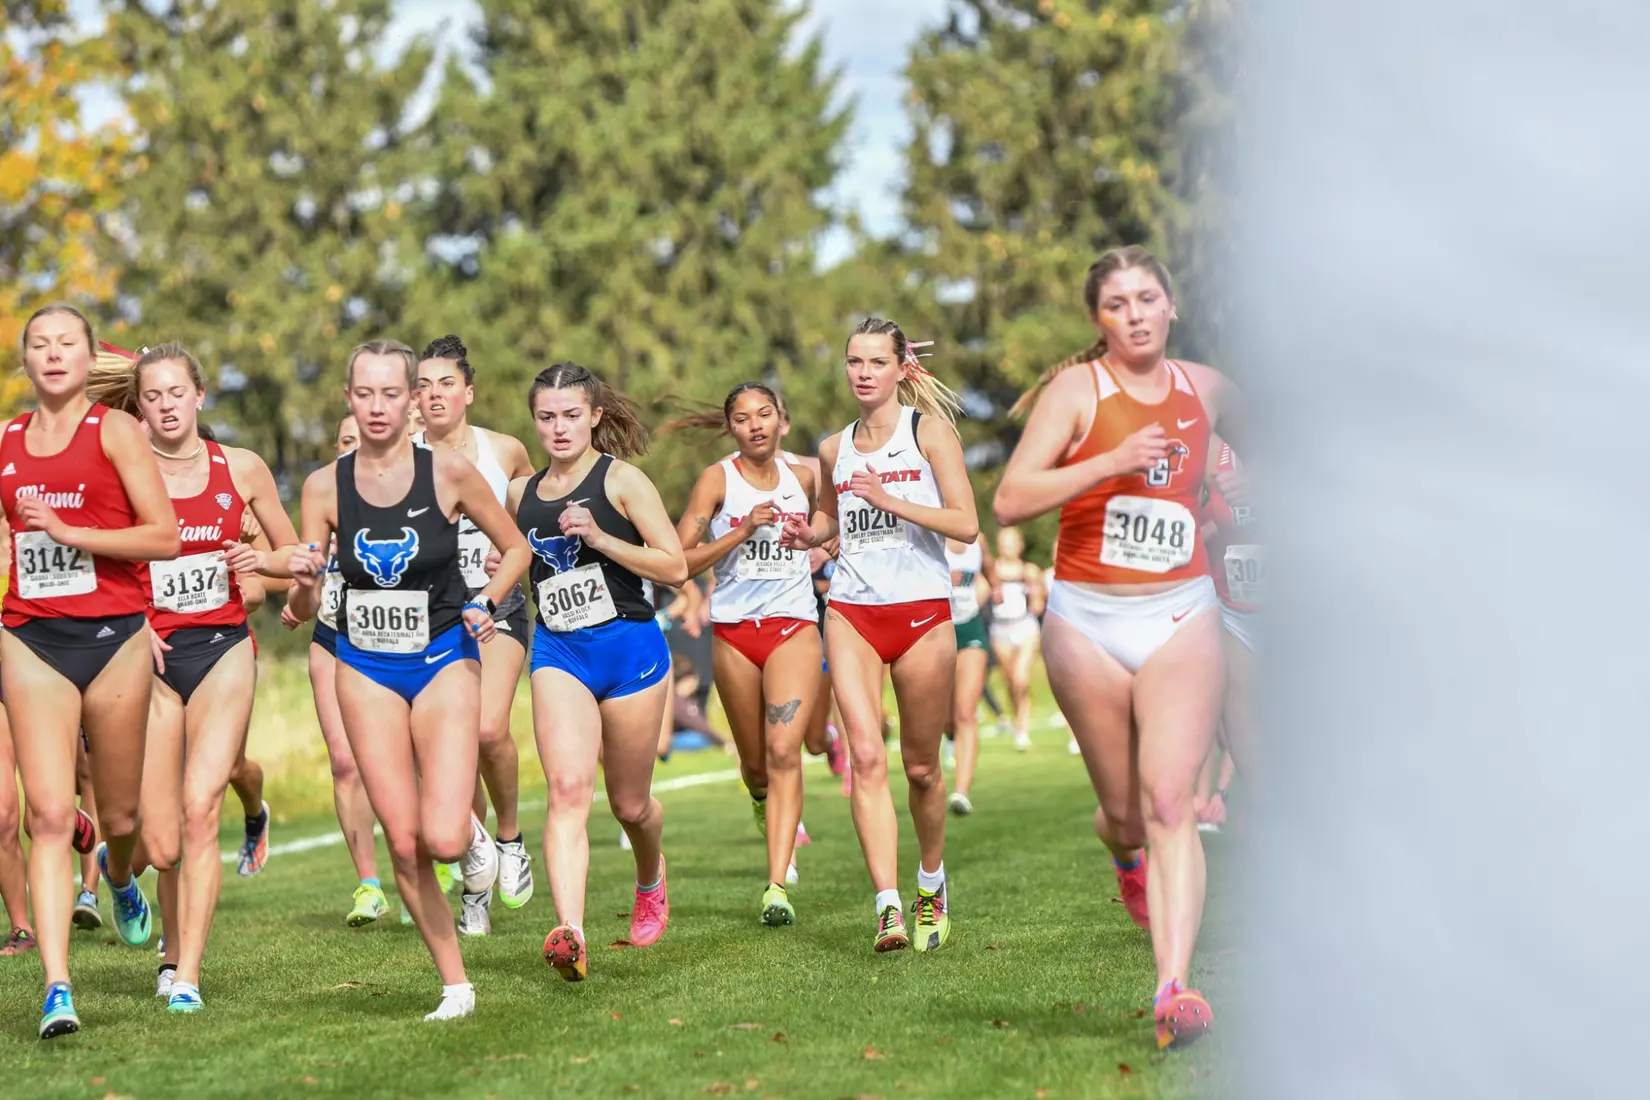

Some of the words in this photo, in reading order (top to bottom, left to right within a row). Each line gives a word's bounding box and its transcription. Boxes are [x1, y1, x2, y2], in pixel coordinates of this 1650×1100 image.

[877, 469, 922, 484] TATE
[16, 484, 86, 509] Miami
[177, 517, 223, 541] iami
[846, 508, 897, 534] 3020
[867, 529, 894, 537] CHRISTMAN
[1115, 512, 1185, 548] 3048
[24, 546, 84, 574] 3142
[745, 540, 793, 561] 3035
[162, 566, 218, 598] 3137
[546, 578, 603, 616] 3062
[356, 605, 419, 630] 3066
[568, 612, 589, 624] BUFFALO
